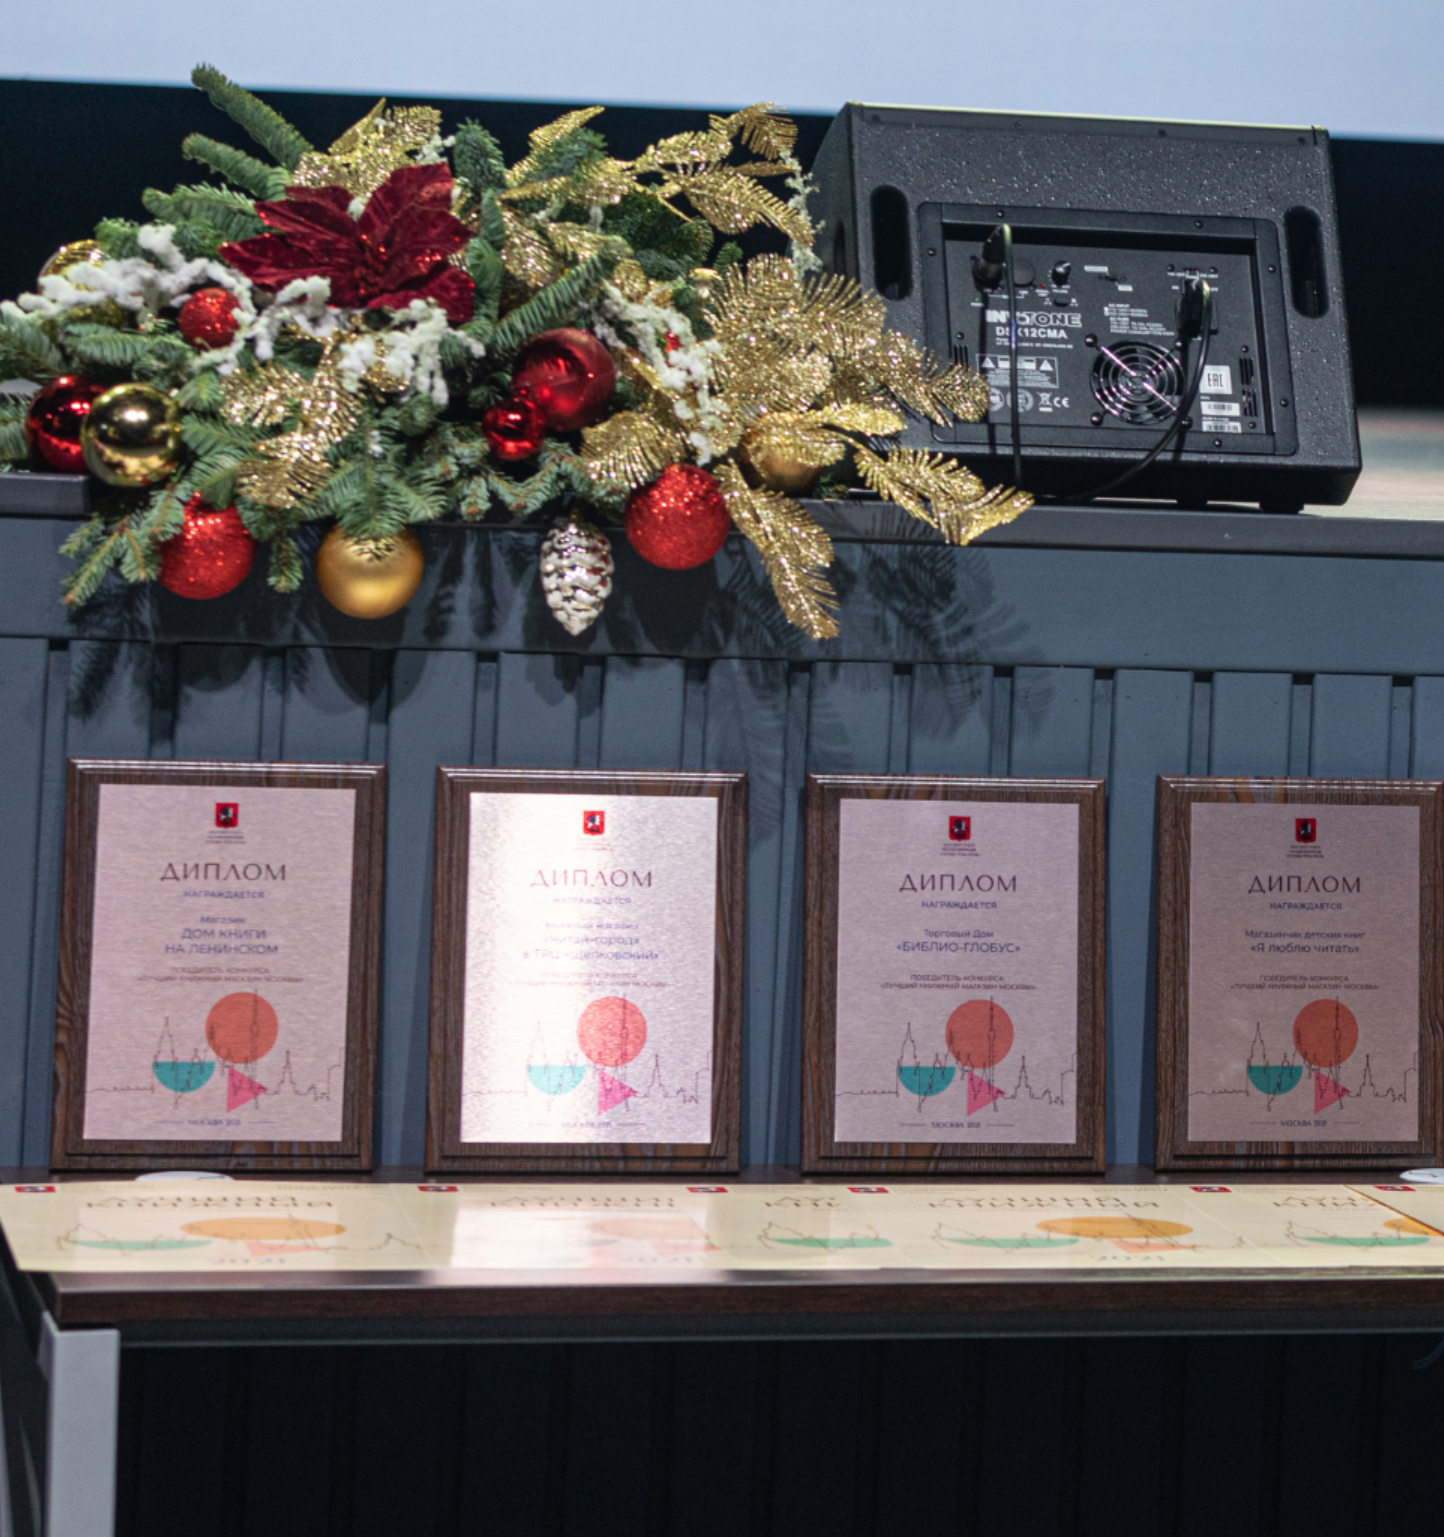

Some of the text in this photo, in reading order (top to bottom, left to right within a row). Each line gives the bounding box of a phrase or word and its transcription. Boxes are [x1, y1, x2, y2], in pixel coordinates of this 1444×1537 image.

[160, 862, 286, 881] ДИПЛОМ
[530, 869, 652, 888] ДИПЛОМ
[899, 873, 1017, 892] ДИПЛОМ
[1248, 875, 1361, 894] ДИПЛОМ
[184, 890, 265, 898] НАГРАЖДАЕТСЯ
[921, 901, 997, 909] НАГРАЖДАЕТСЯ
[1269, 902, 1342, 910] НАГРАЖДАЕТСЯ
[181, 928, 266, 940] ДОМ КНИГИ
[923, 929, 994, 938] Торговый Дом
[165, 944, 278, 954] НА ЛЕНИНСКОМ
[896, 941, 1021, 953] «БИБЛИО-ГЛОБУС»
[1251, 942, 1360, 953] «Я люблю читать»
